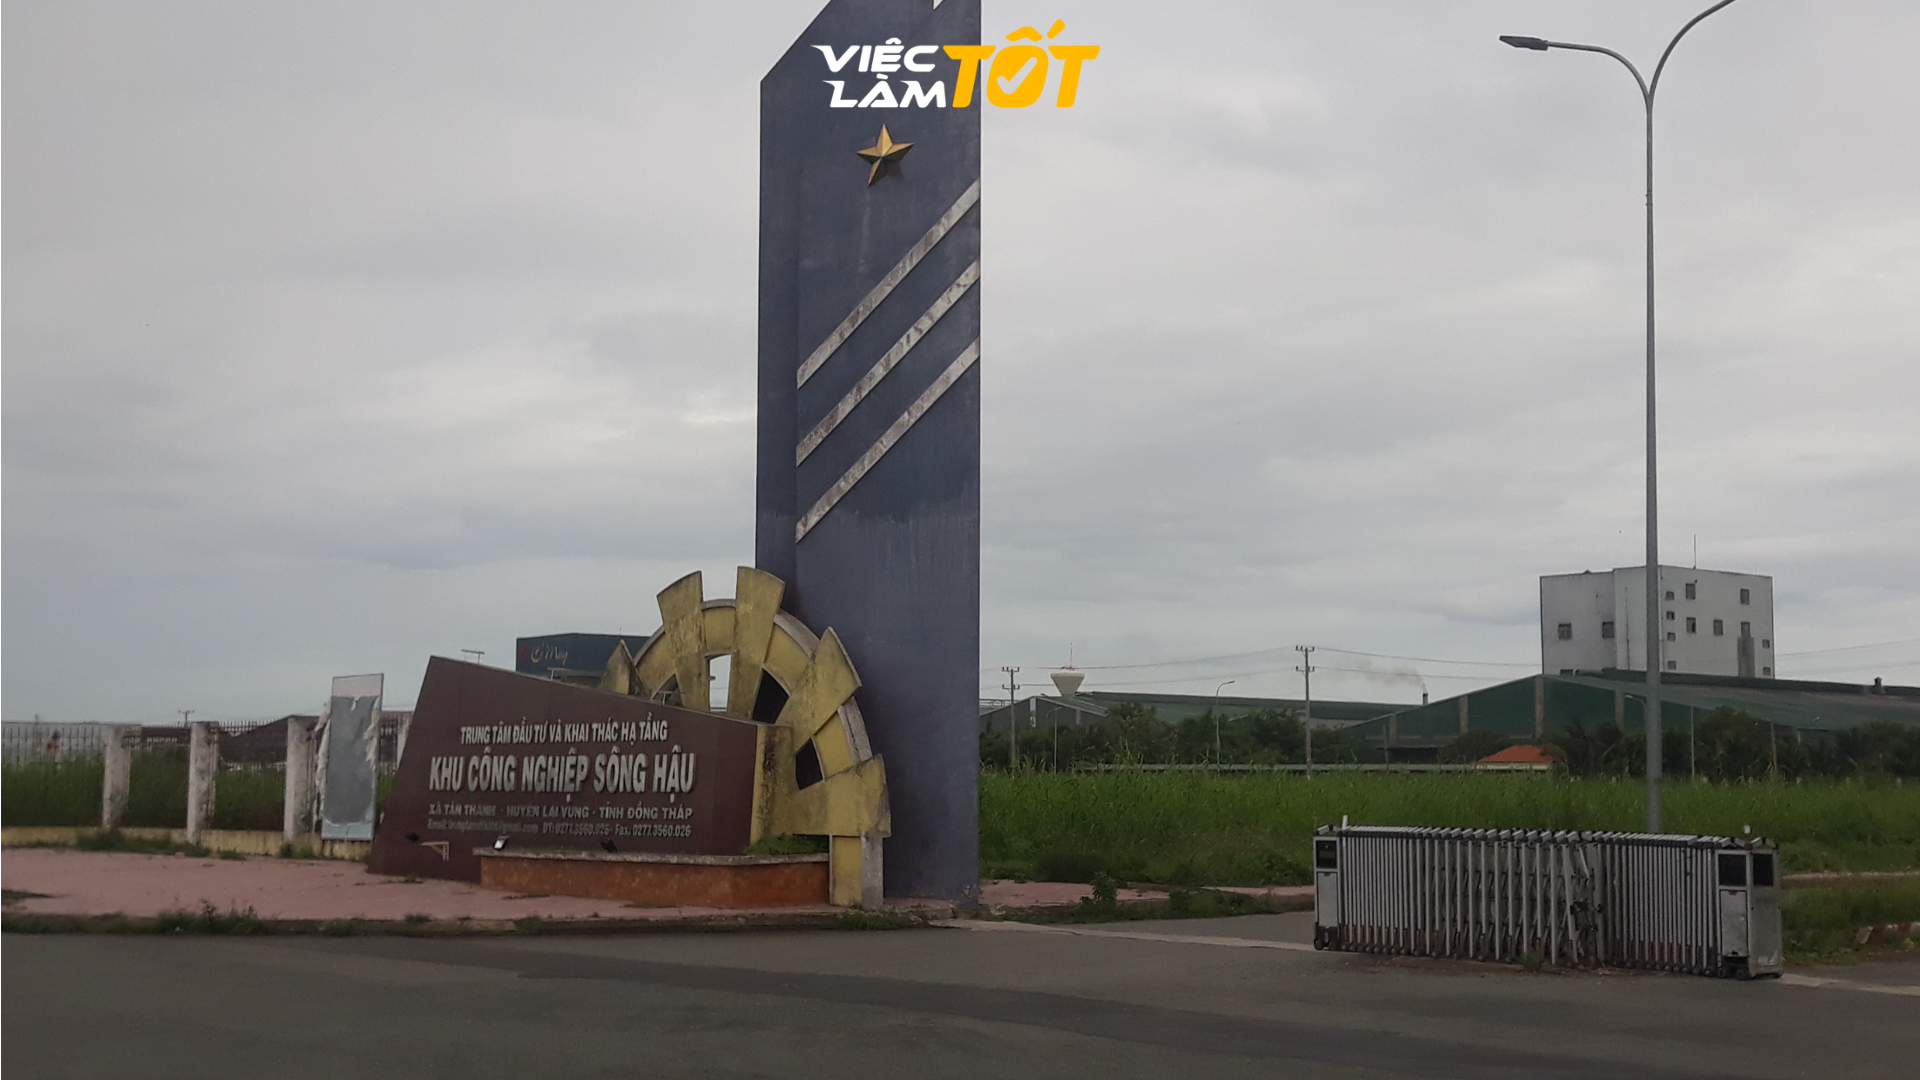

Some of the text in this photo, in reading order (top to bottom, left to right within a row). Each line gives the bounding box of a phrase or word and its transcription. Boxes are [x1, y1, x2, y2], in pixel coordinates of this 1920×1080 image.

[461, 711, 668, 746] TRUNG TÂM ĐẦU TƯ VÀ KHAI THÁC HẠ TẦNG
[429, 744, 696, 803] KHU CÔNG NGHIỆP SÔNG HẬU
[542, 804, 559, 818] LAI
[561, 805, 590, 819] VUNG
[662, 803, 693, 820] THÁP
